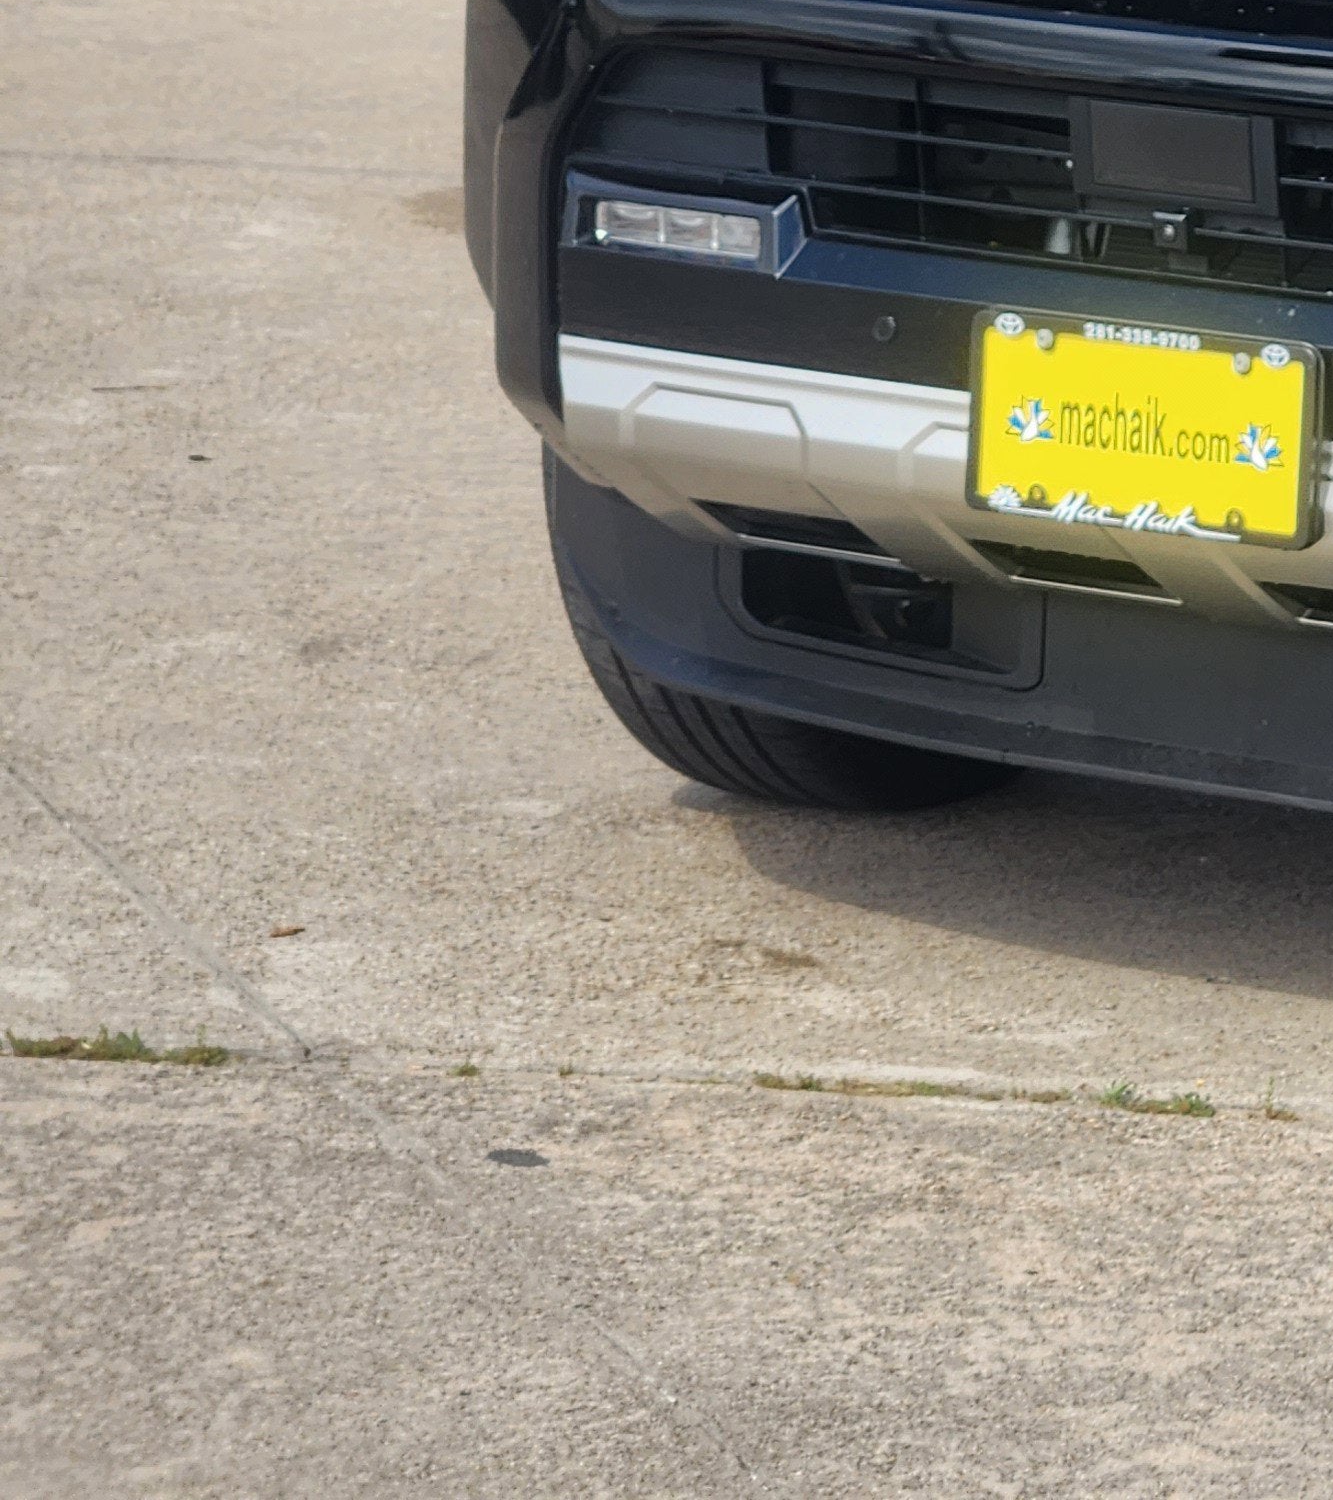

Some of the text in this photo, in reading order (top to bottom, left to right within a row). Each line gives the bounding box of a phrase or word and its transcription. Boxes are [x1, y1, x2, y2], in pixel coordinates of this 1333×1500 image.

[1058, 392, 1231, 464] machaik.com
[1052, 491, 1197, 534] Mac Haik
